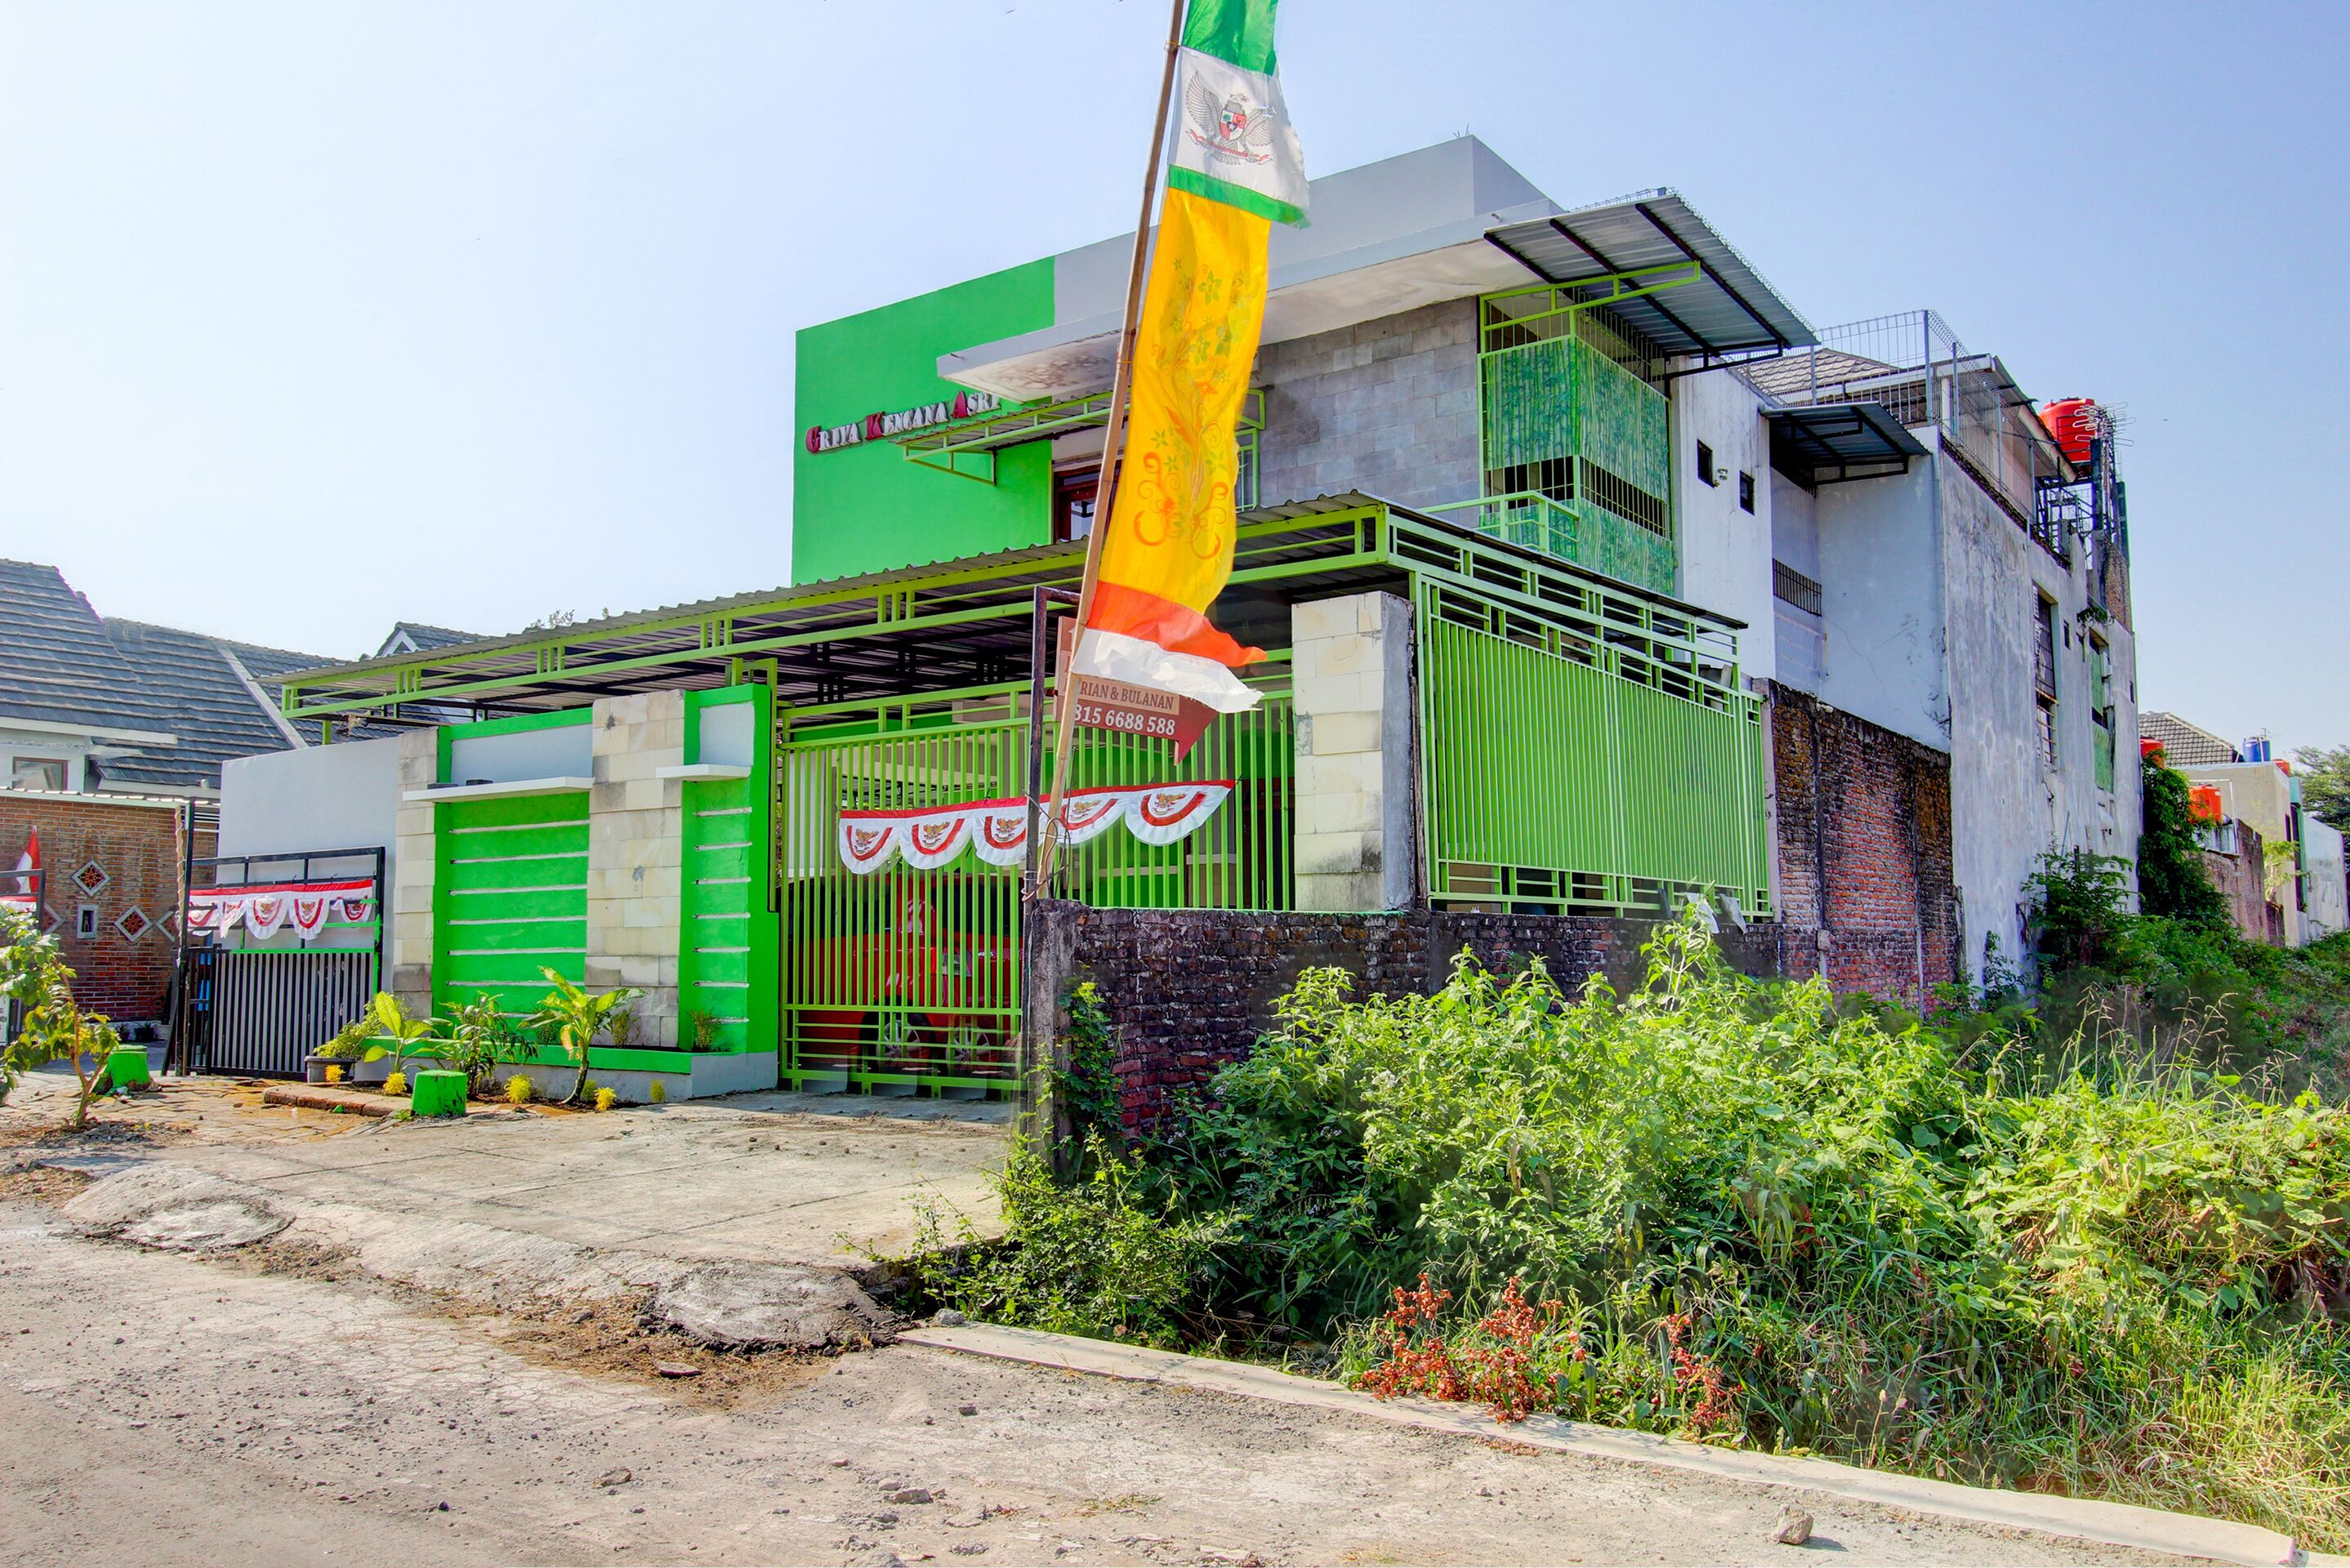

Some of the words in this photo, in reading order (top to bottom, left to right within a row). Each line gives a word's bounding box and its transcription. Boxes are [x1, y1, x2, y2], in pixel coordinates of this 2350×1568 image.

[805, 424, 862, 453] GRIYA
[865, 402, 948, 441] KENCANA
[951, 390, 1001, 419] ASRI
[1110, 686, 1119, 701] &
[1120, 688, 1174, 710] BULANAN
[1075, 704, 1103, 724] 815
[1104, 709, 1144, 731] 6688
[1147, 715, 1175, 736] 588
